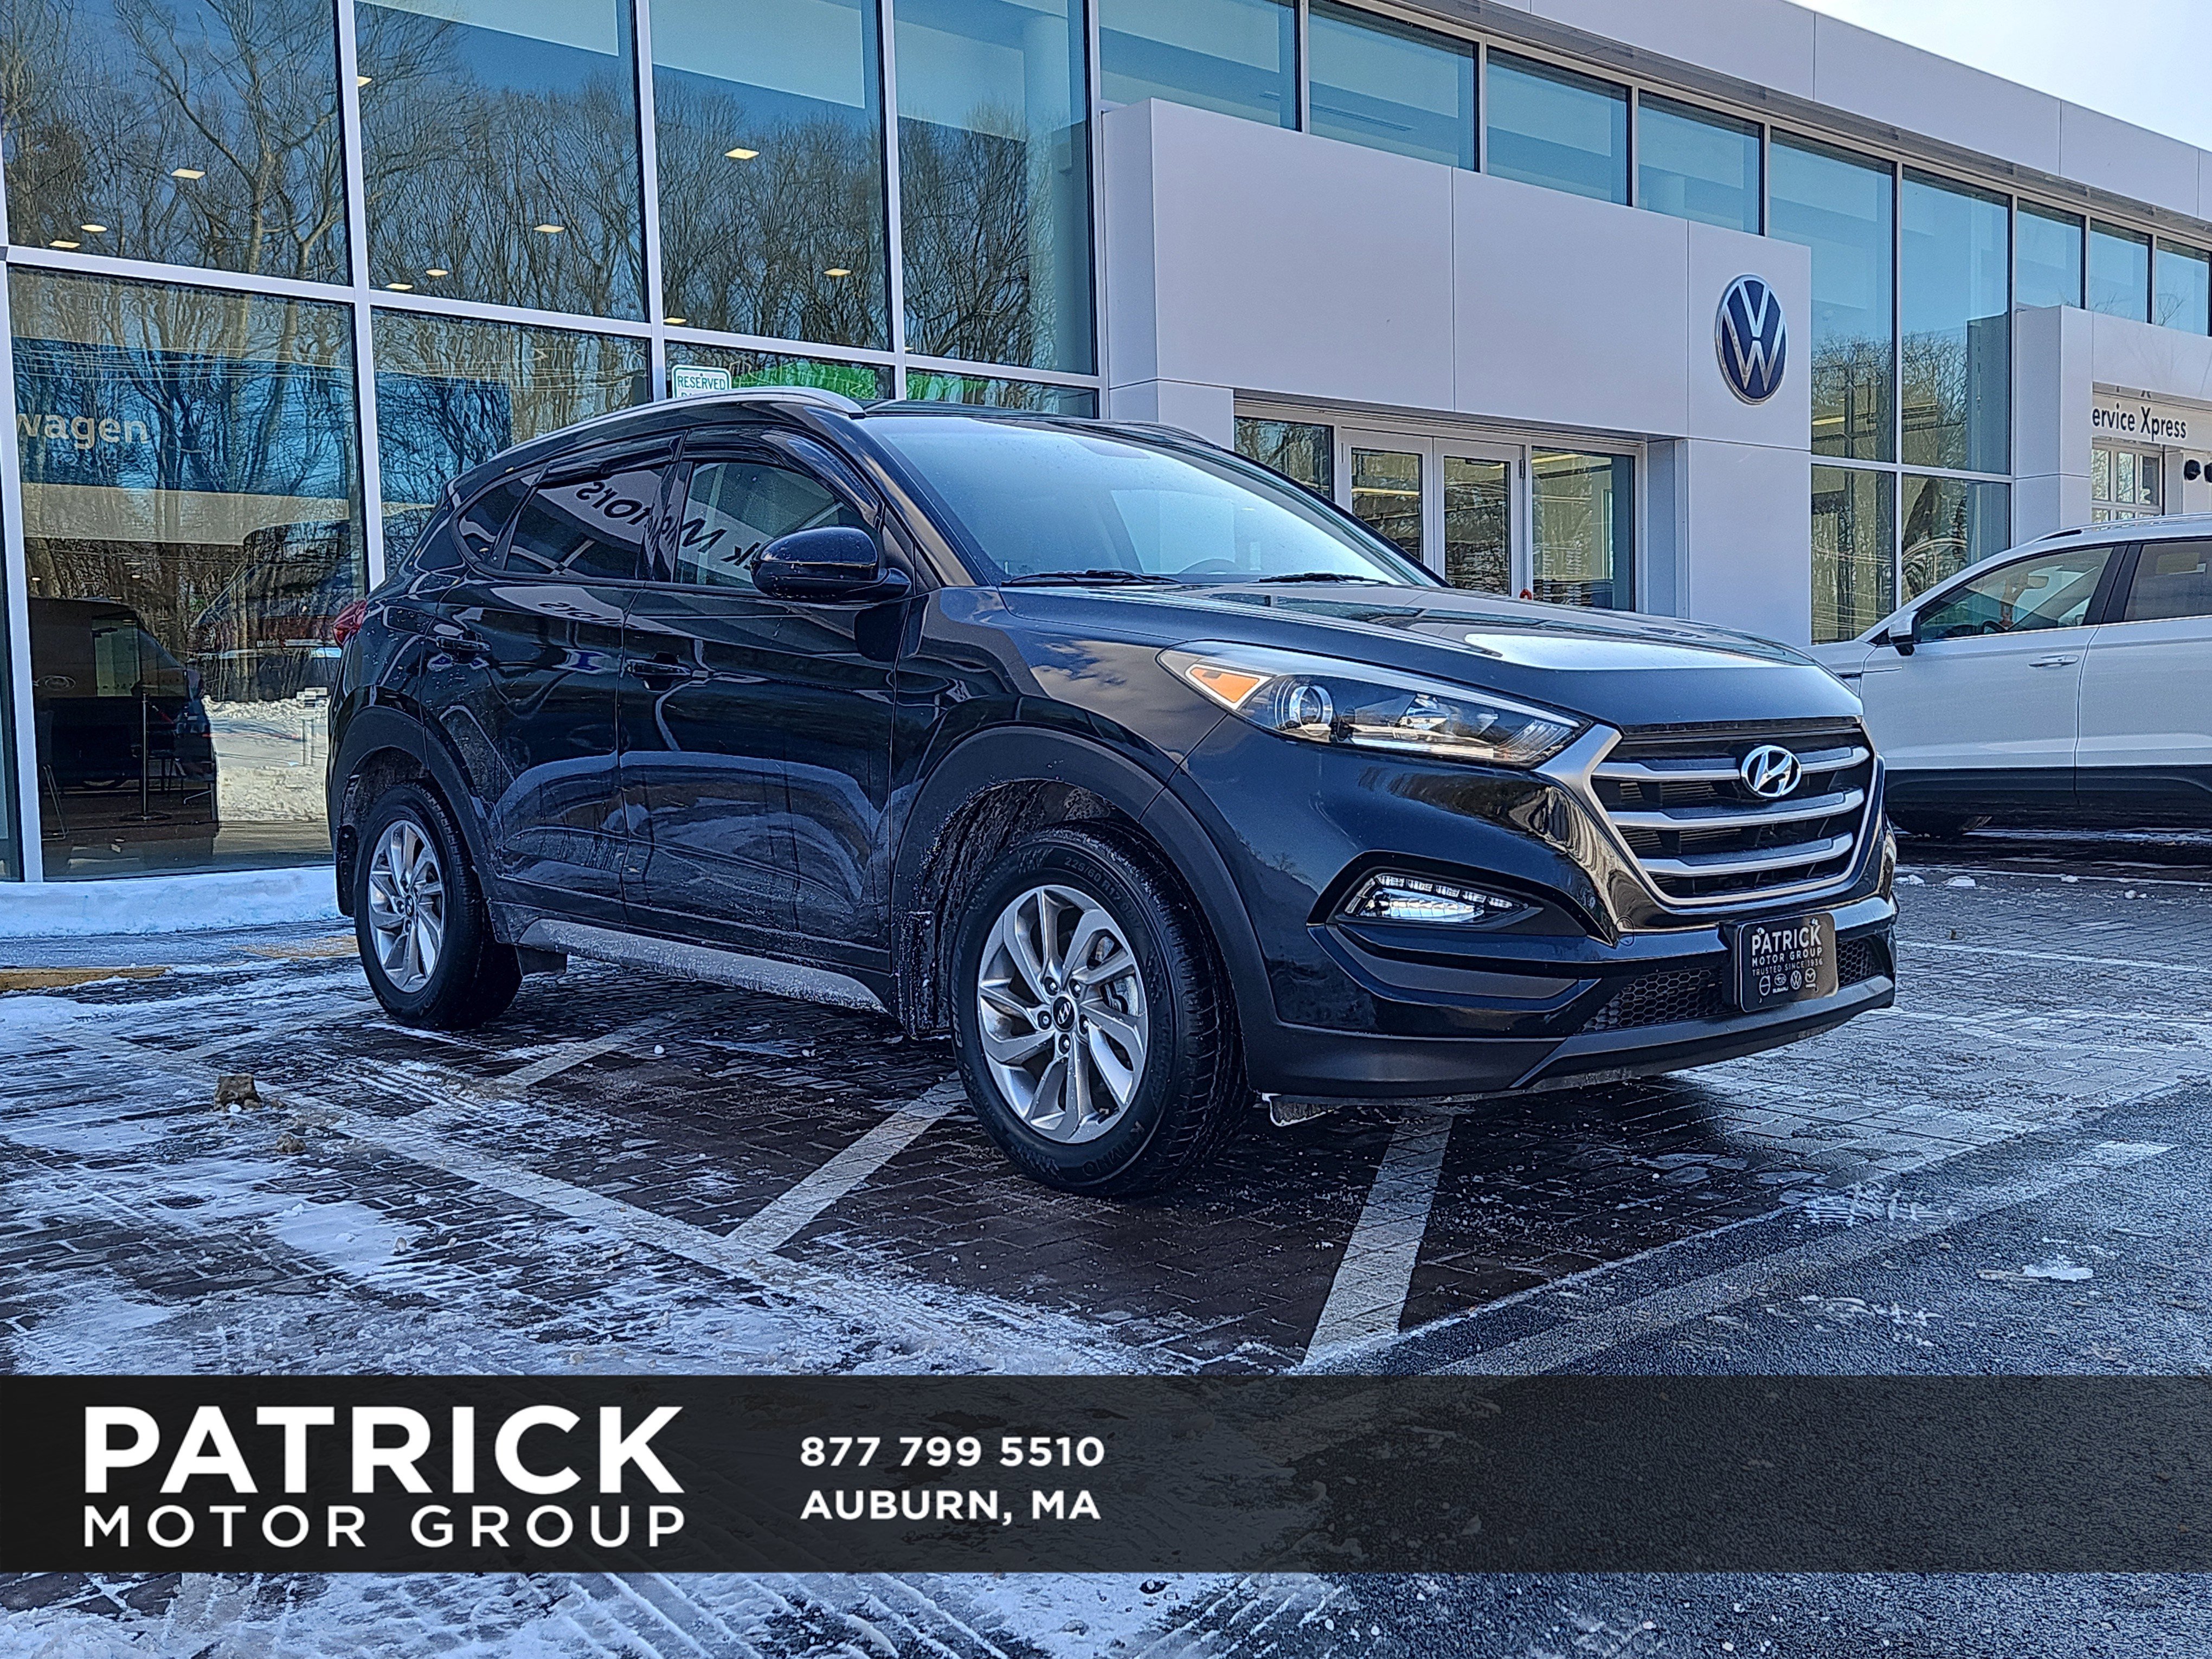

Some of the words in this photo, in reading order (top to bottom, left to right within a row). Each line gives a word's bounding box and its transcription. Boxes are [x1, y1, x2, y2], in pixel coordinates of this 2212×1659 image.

[678, 375, 726, 390] RESERVED
[2092, 402, 2136, 432] ervice
[2140, 406, 2187, 441] Xpress
[1752, 924, 1822, 956] PATRICK
[1752, 953, 1784, 968] MOTOR
[1790, 947, 1822, 960] GROUP
[1752, 965, 1782, 976] TRUSTED
[1785, 961, 1804, 971] SINCE
[1808, 957, 1823, 967] 1936
